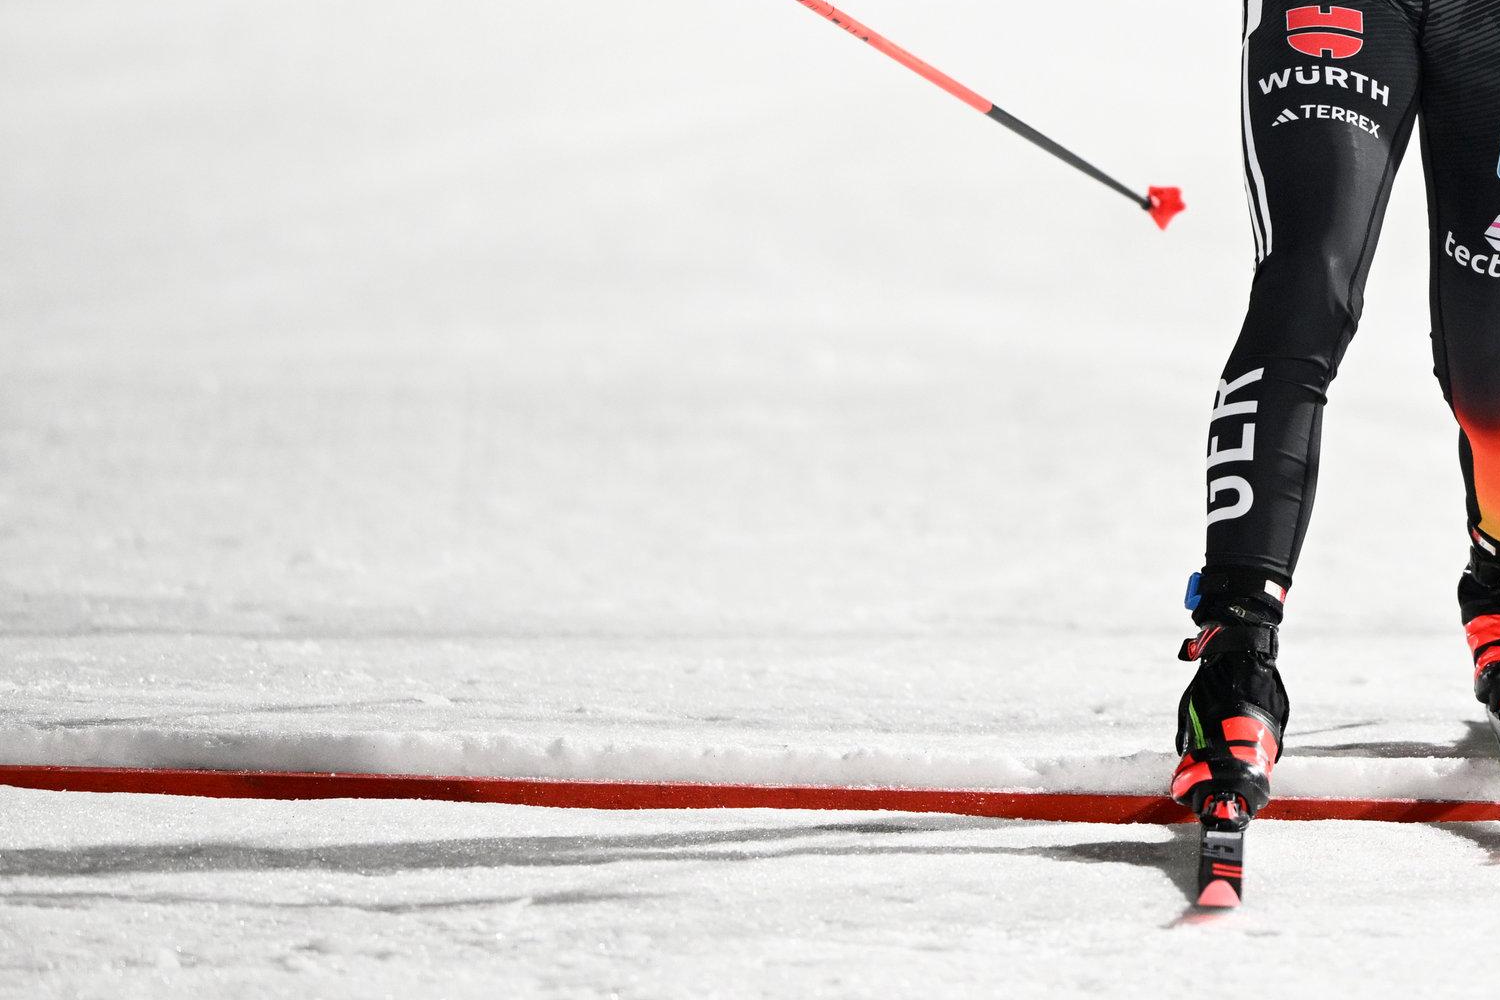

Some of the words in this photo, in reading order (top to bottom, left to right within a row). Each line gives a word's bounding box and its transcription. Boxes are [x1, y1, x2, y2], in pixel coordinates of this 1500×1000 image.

[1258, 65, 1390, 107] WÜRTH
[1300, 104, 1381, 139] TERREX
[1206, 366, 1265, 529] GER
